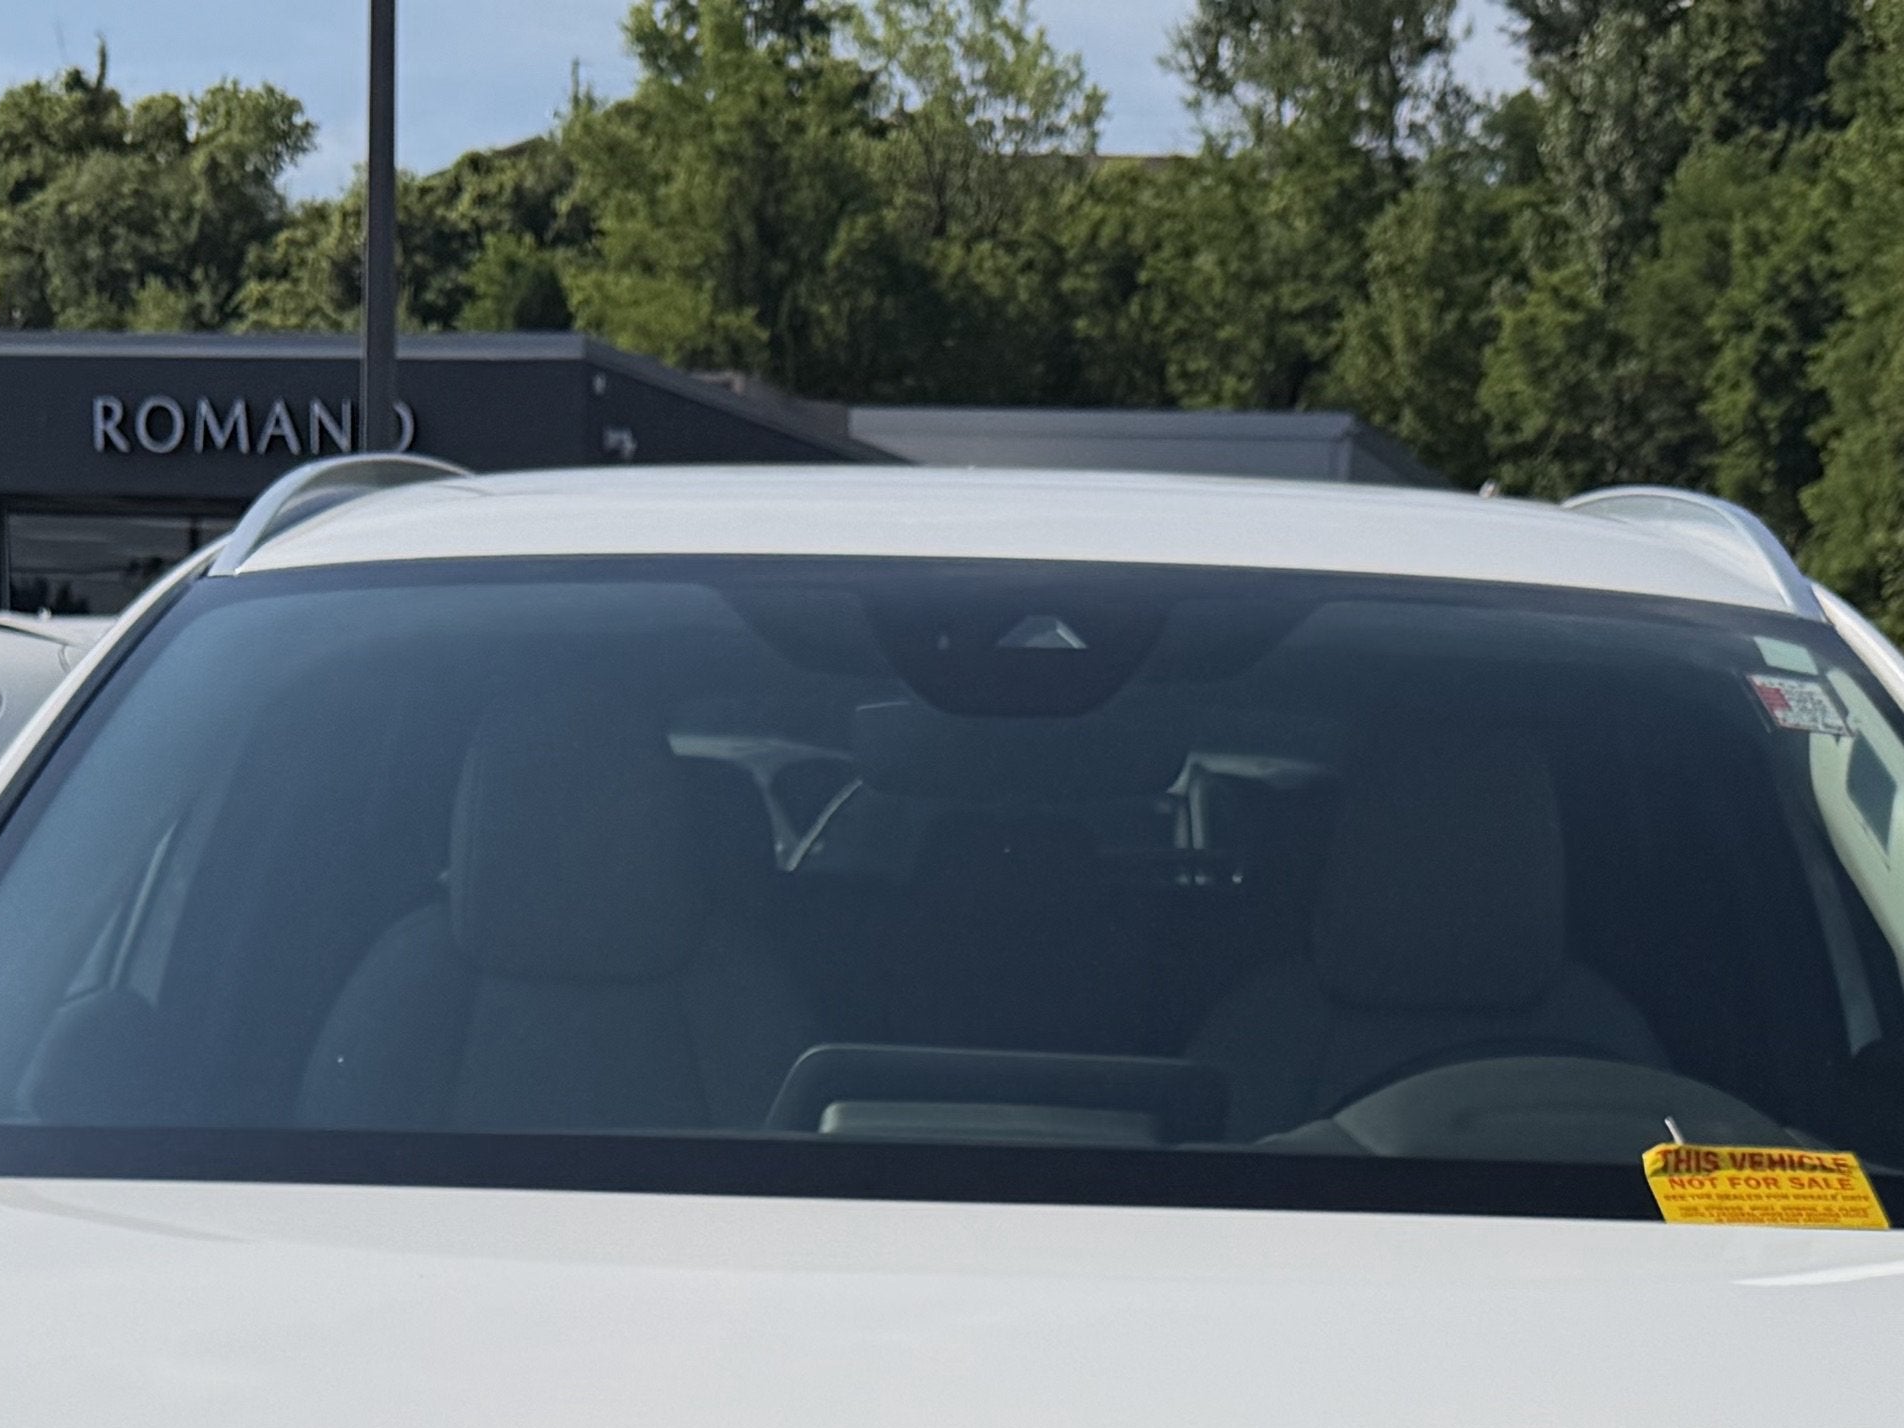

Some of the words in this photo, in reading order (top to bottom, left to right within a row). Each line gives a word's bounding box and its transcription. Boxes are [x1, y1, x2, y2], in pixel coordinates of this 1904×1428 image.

[1657, 1149, 1720, 1172] THIS
[1669, 1176, 1719, 1191] NOT
[1728, 1176, 1778, 1191] FOR
[1788, 1177, 1855, 1191] SALE
